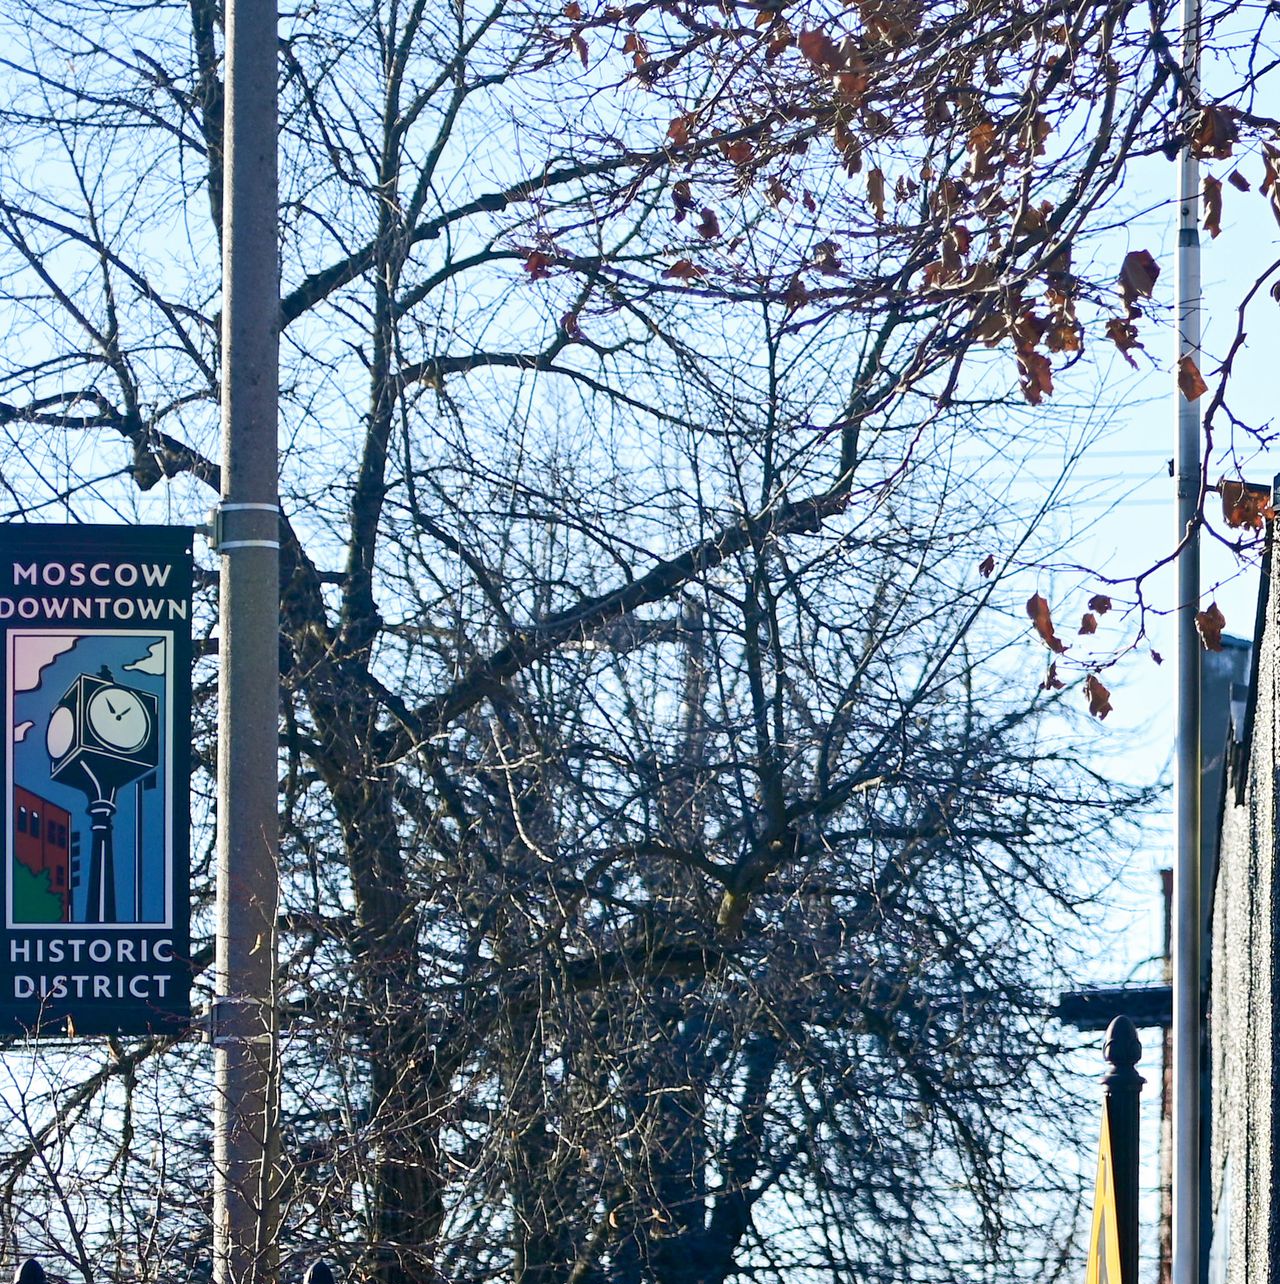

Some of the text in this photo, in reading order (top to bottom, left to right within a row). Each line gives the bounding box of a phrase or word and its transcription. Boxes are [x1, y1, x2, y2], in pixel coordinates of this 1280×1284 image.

[13, 562, 172, 587] MOSCOW
[0, 596, 188, 620] DOWNTOWN
[9, 938, 175, 963] HISTORIC
[14, 974, 172, 999] DISTRICT
